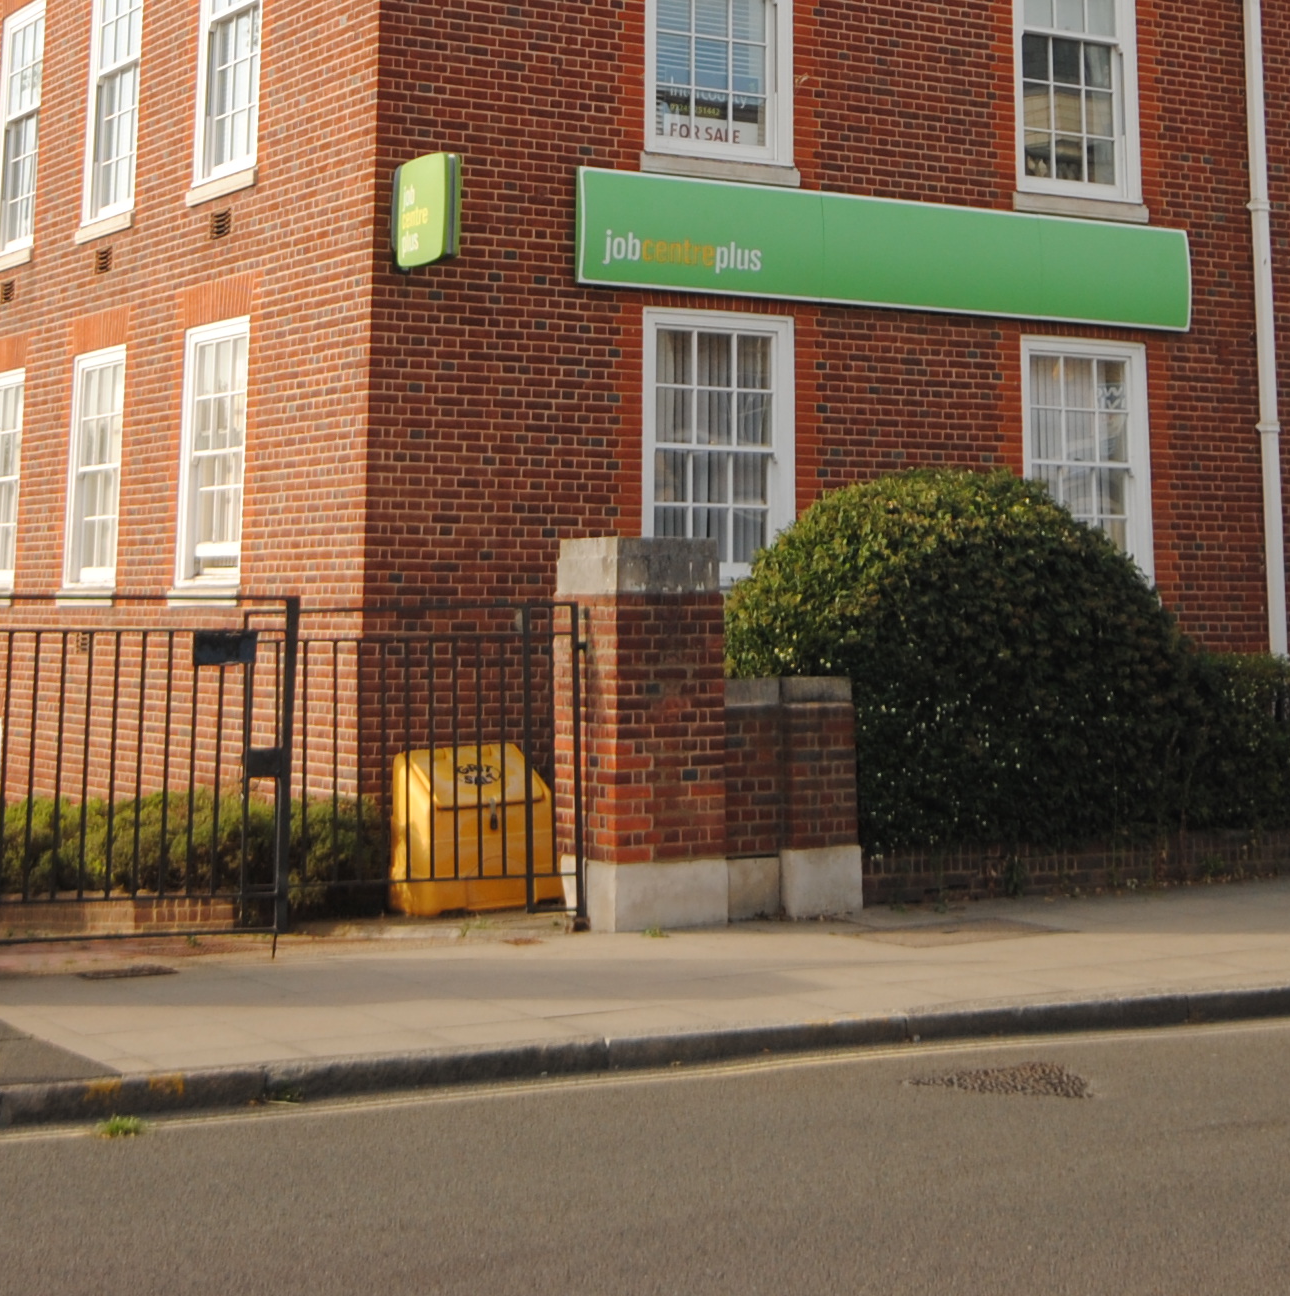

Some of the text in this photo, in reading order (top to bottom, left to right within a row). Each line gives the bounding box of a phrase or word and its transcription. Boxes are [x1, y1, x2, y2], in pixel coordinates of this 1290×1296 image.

[670, 123, 700, 140] FOR
[402, 184, 415, 212] job
[402, 207, 428, 230] centre
[402, 231, 419, 258] plus
[602, 229, 762, 274] jobcentreplus
